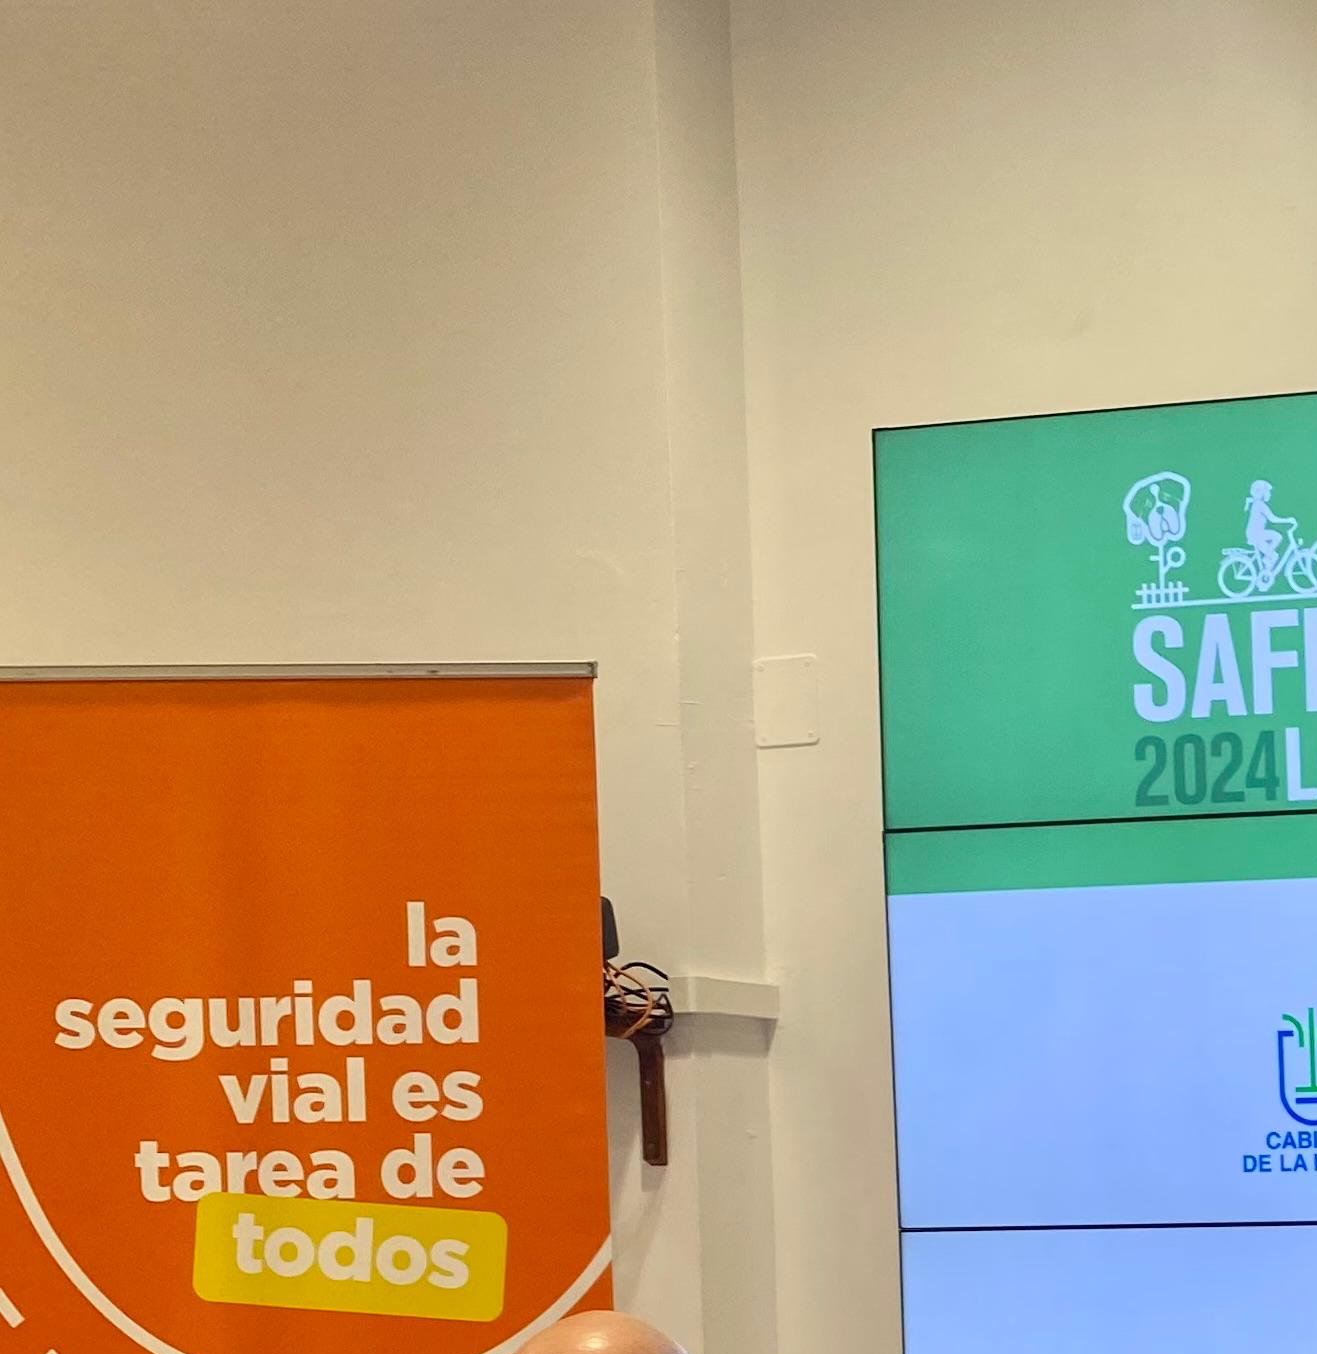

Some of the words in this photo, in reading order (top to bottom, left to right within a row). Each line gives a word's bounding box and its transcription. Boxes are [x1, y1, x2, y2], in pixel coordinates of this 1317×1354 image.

[407, 901, 478, 967] la
[54, 977, 480, 1061] seguridad
[218, 1056, 367, 1124] vial
[392, 1068, 484, 1122] es
[134, 1140, 355, 1202] tarea
[380, 1133, 485, 1199] de
[1243, 1155, 1271, 1173] DE
[1280, 1153, 1307, 1172] LA
[232, 1212, 470, 1288] todos
